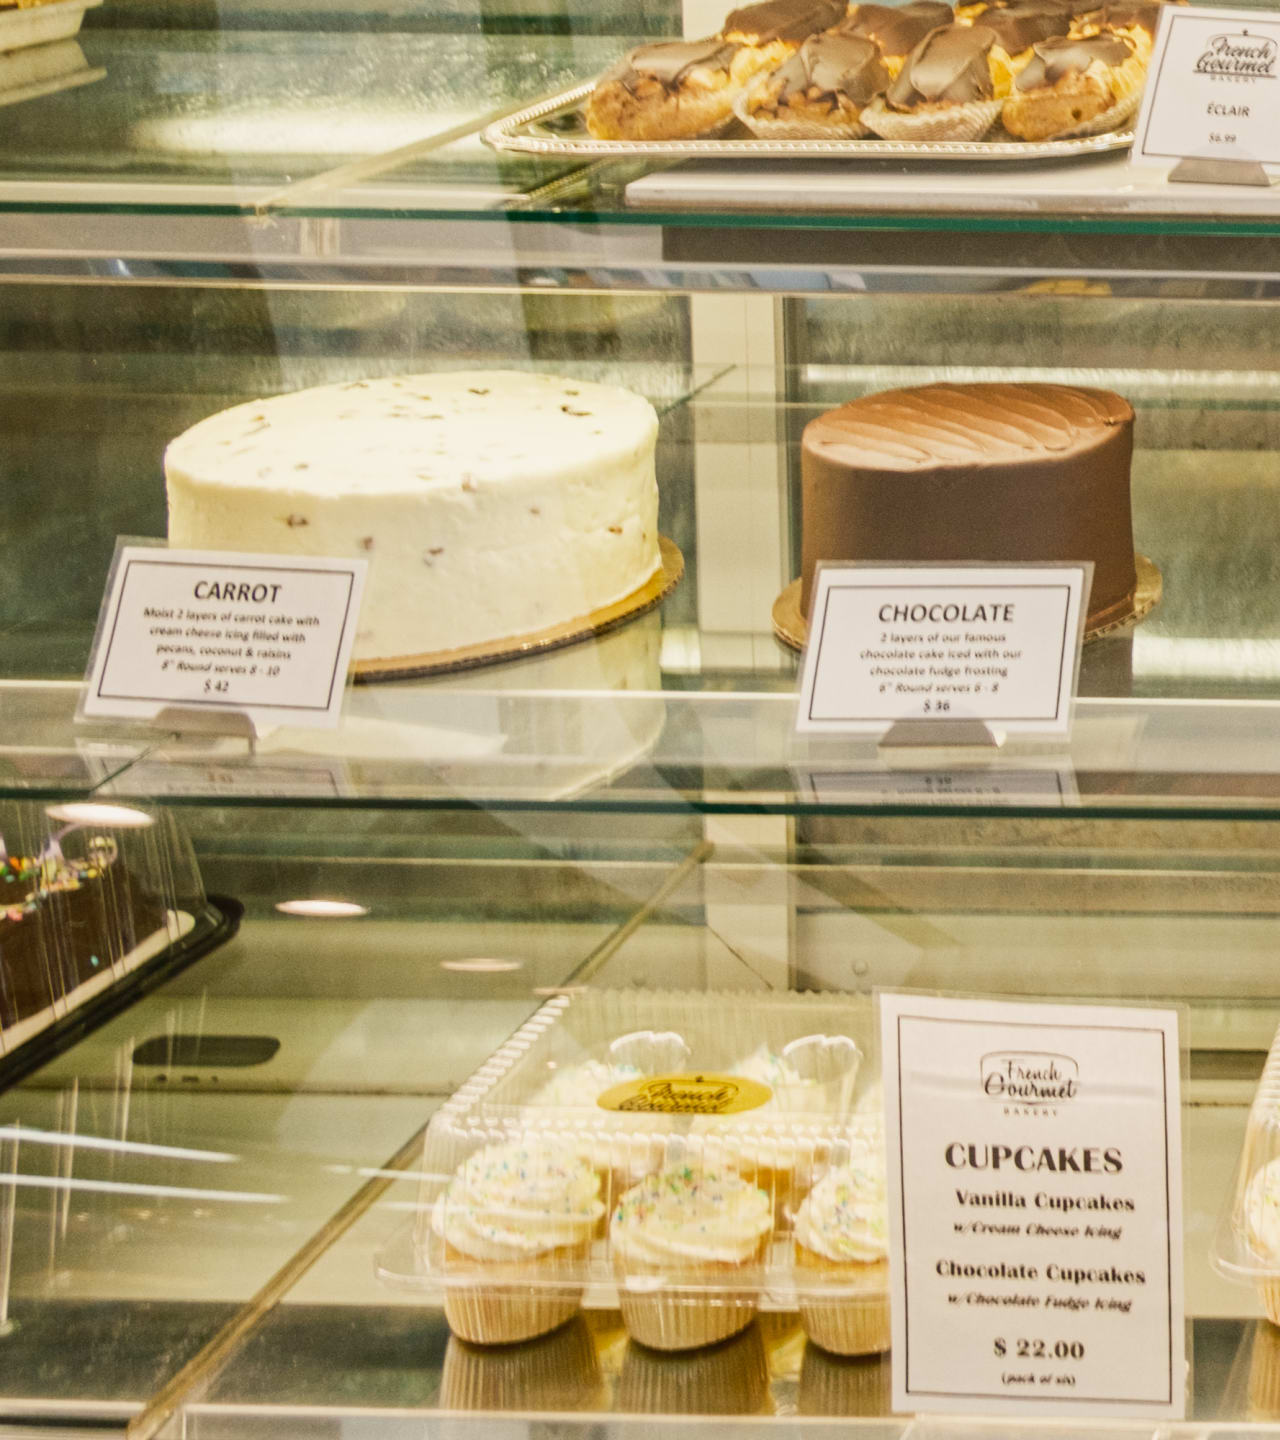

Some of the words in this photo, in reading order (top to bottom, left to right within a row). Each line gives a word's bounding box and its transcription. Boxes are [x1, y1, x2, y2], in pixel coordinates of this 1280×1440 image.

[194, 580, 281, 603] CARROT
[878, 604, 1015, 622] CHOCOLATE
[214, 680, 229, 693] 42
[1006, 1060, 1061, 1082] French
[984, 1073, 1078, 1100] Gourmet
[944, 1143, 1124, 1174] CUPCAKES
[956, 1189, 1026, 1209] Vanilla
[1034, 1191, 1136, 1212] Cupcakes
[935, 1260, 1038, 1280] Chocolate
[1046, 1263, 1146, 1285] Cupcakes
[994, 1339, 1007, 1358] $
[1016, 1339, 1085, 1360] 22.00
